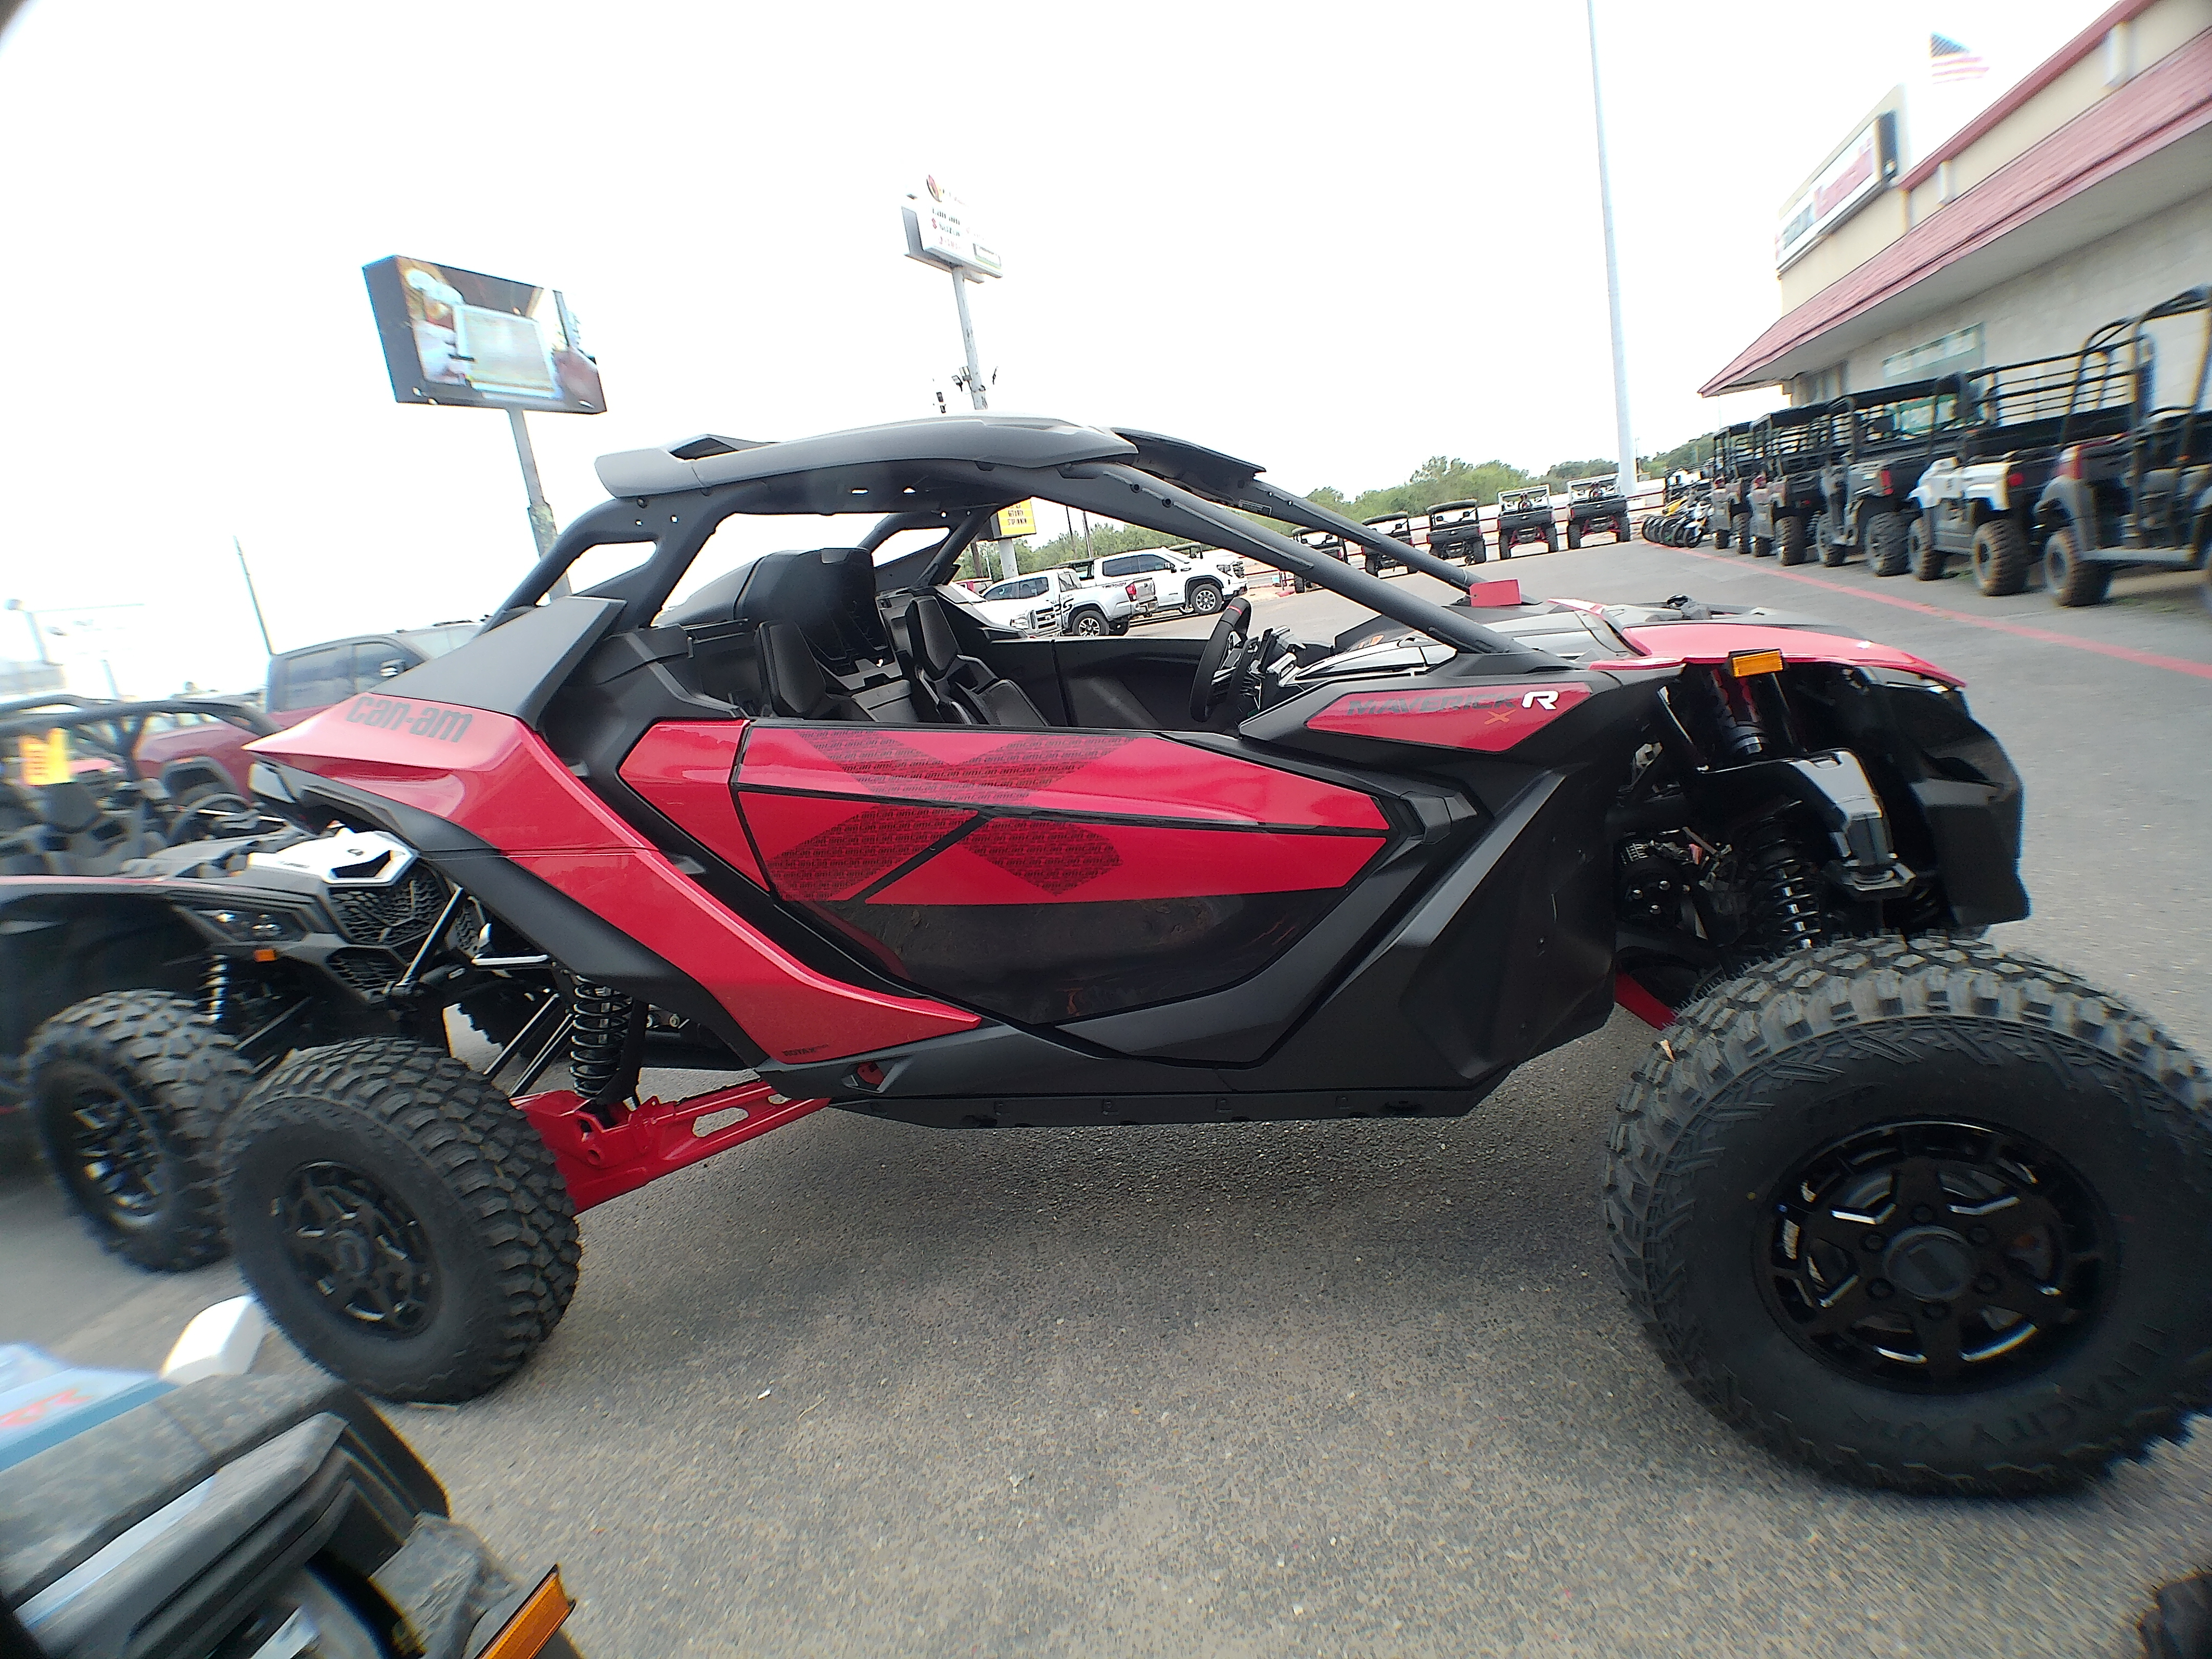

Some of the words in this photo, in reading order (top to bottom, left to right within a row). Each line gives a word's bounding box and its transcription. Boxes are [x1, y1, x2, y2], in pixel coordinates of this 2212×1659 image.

[1347, 692, 1517, 715] MAVERICK
[1521, 690, 1559, 710] R
[346, 696, 473, 743] can-am
[1484, 709, 1517, 725] X
